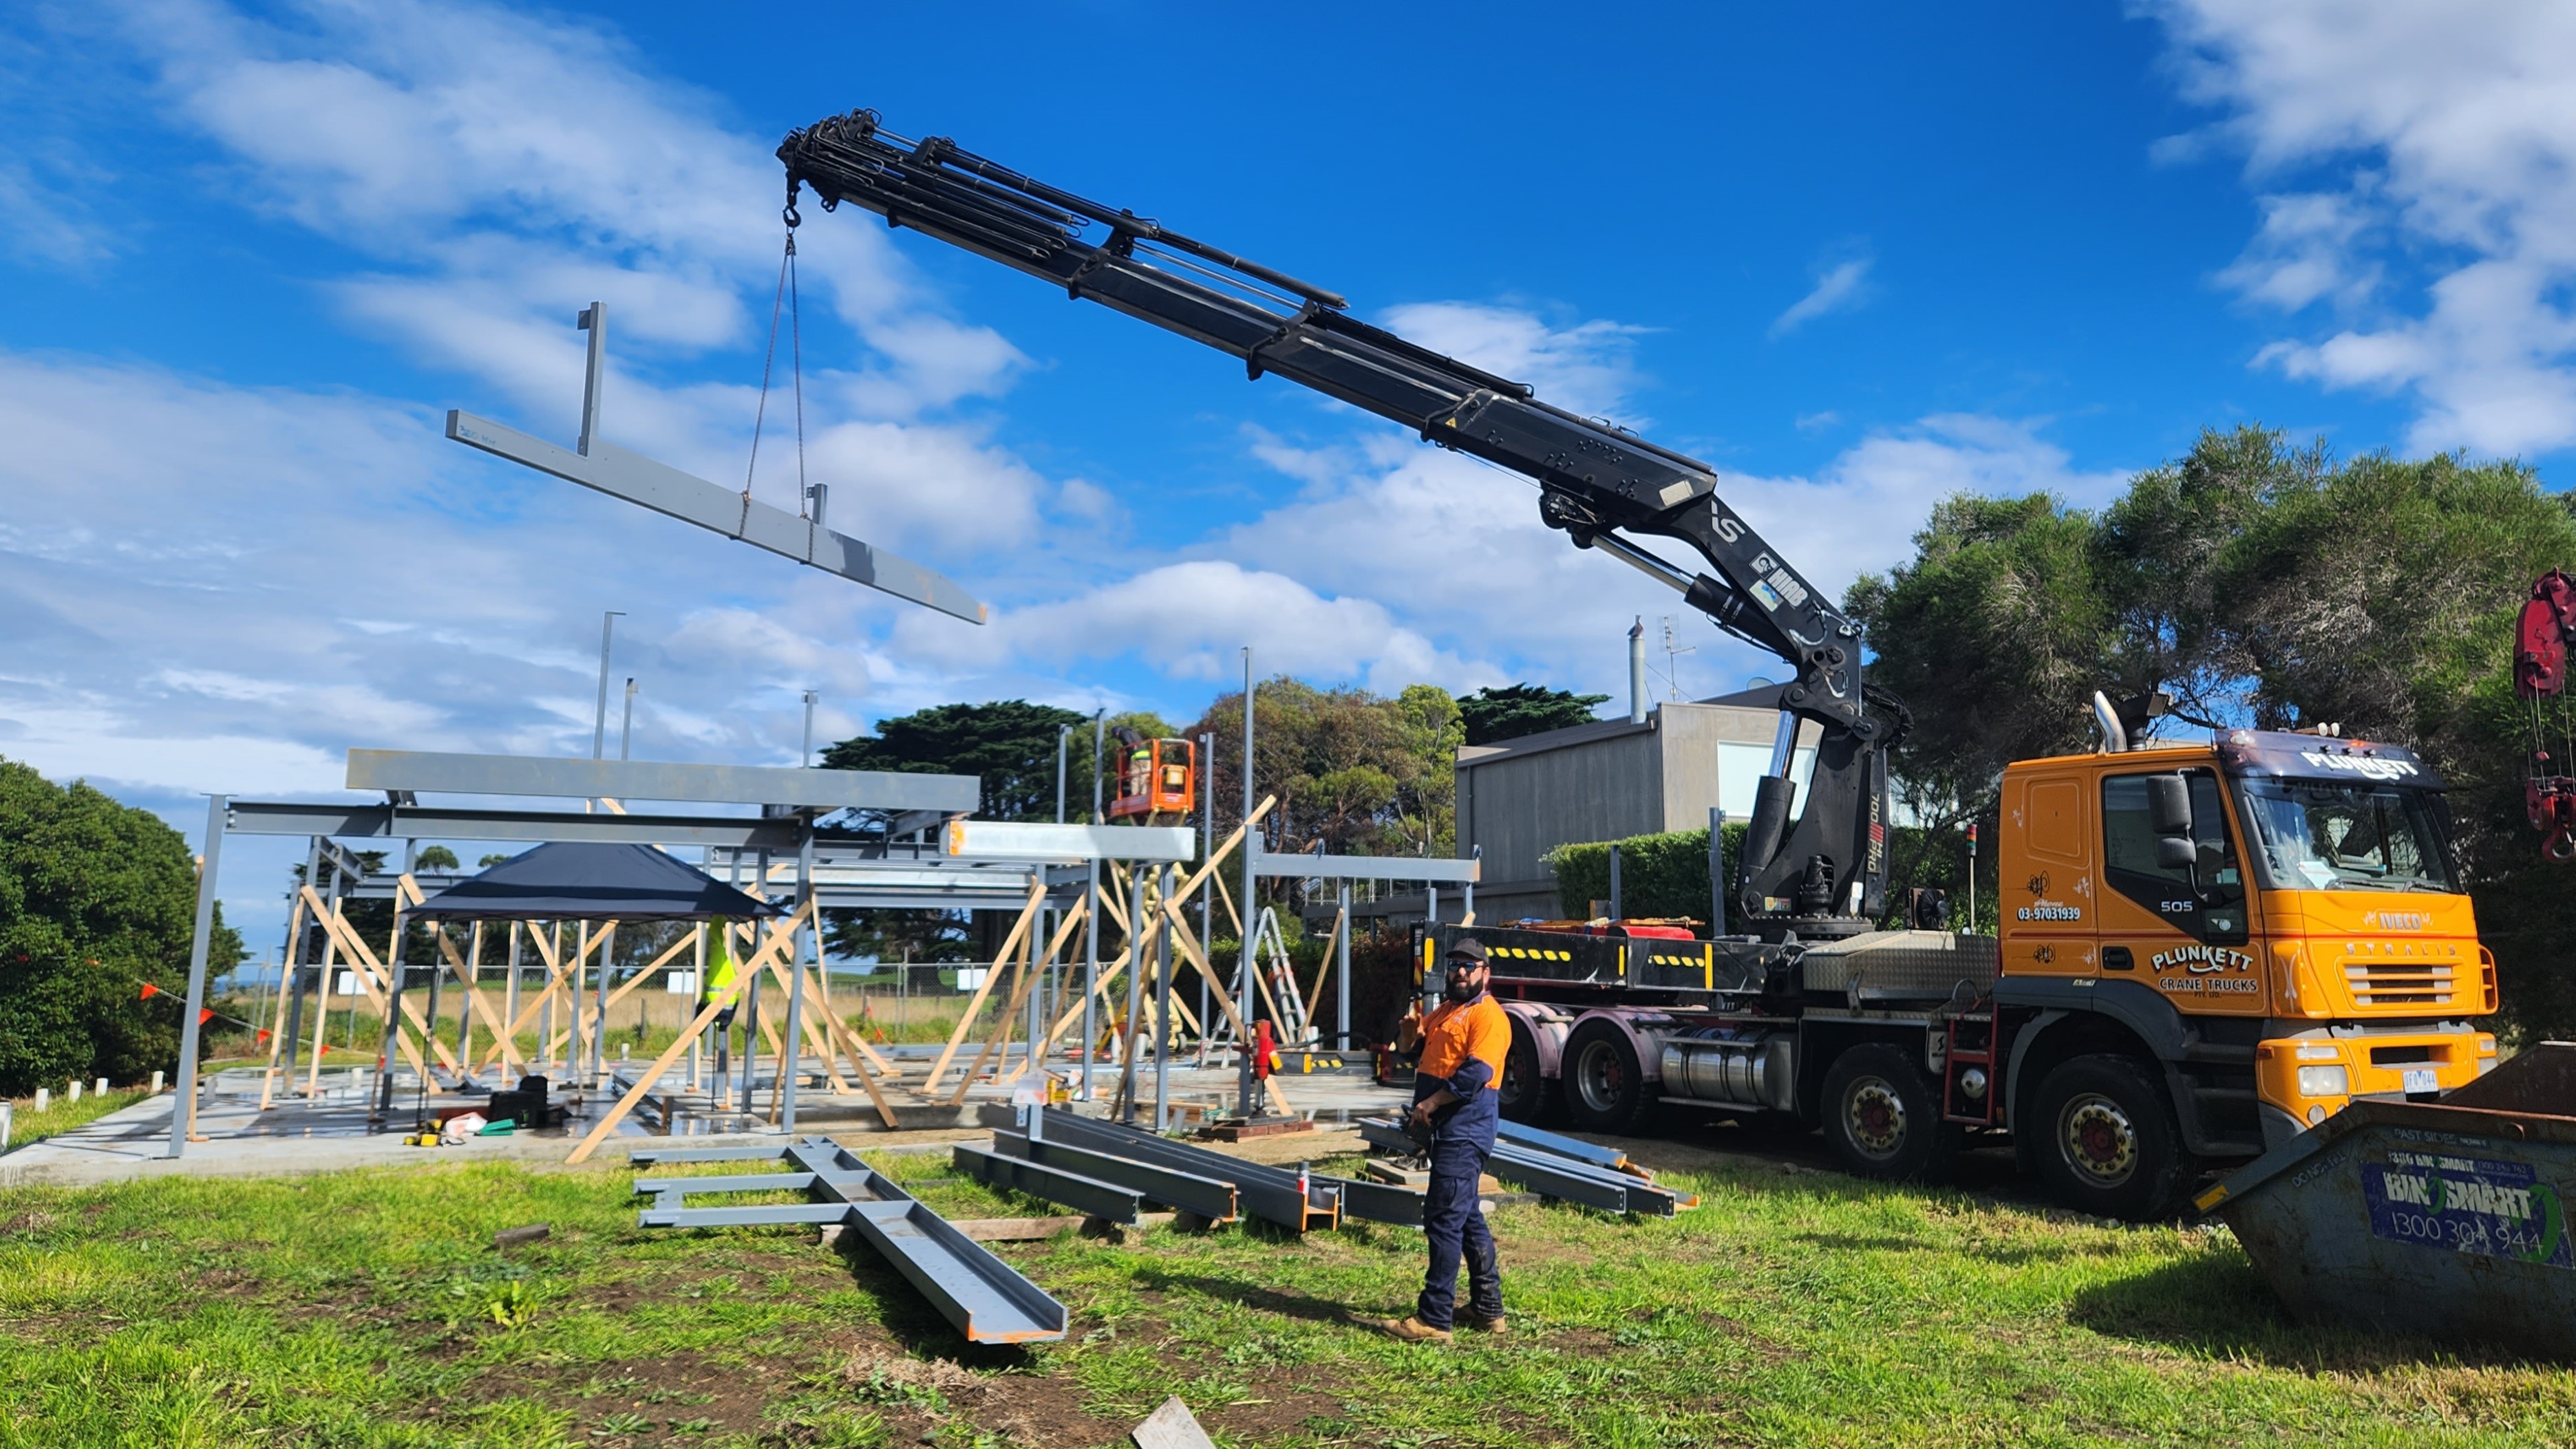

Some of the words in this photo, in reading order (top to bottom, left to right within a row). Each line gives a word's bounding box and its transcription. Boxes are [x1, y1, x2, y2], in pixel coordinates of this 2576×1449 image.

[1767, 567, 1809, 607] HIAB
[2300, 751, 2419, 780] PLUNKETT
[1870, 793, 1880, 823] 700
[1868, 838, 1877, 871] PRO
[2017, 907, 2080, 921] 03-97031939
[2034, 898, 2063, 908] Phone
[2161, 901, 2193, 912] 505
[2378, 912, 2422, 930] IVECO
[2151, 945, 2254, 973] PLUNKETT
[2345, 943, 2456, 956] STRALIS
[2159, 977, 2202, 991] CRANE
[2206, 977, 2257, 992] TRUCKS
[2383, 1171, 2431, 1205] BIN
[2443, 1179, 2532, 1221] SMART
[2392, 1211, 2442, 1239] 1300
[2495, 1227, 2544, 1256] 944
